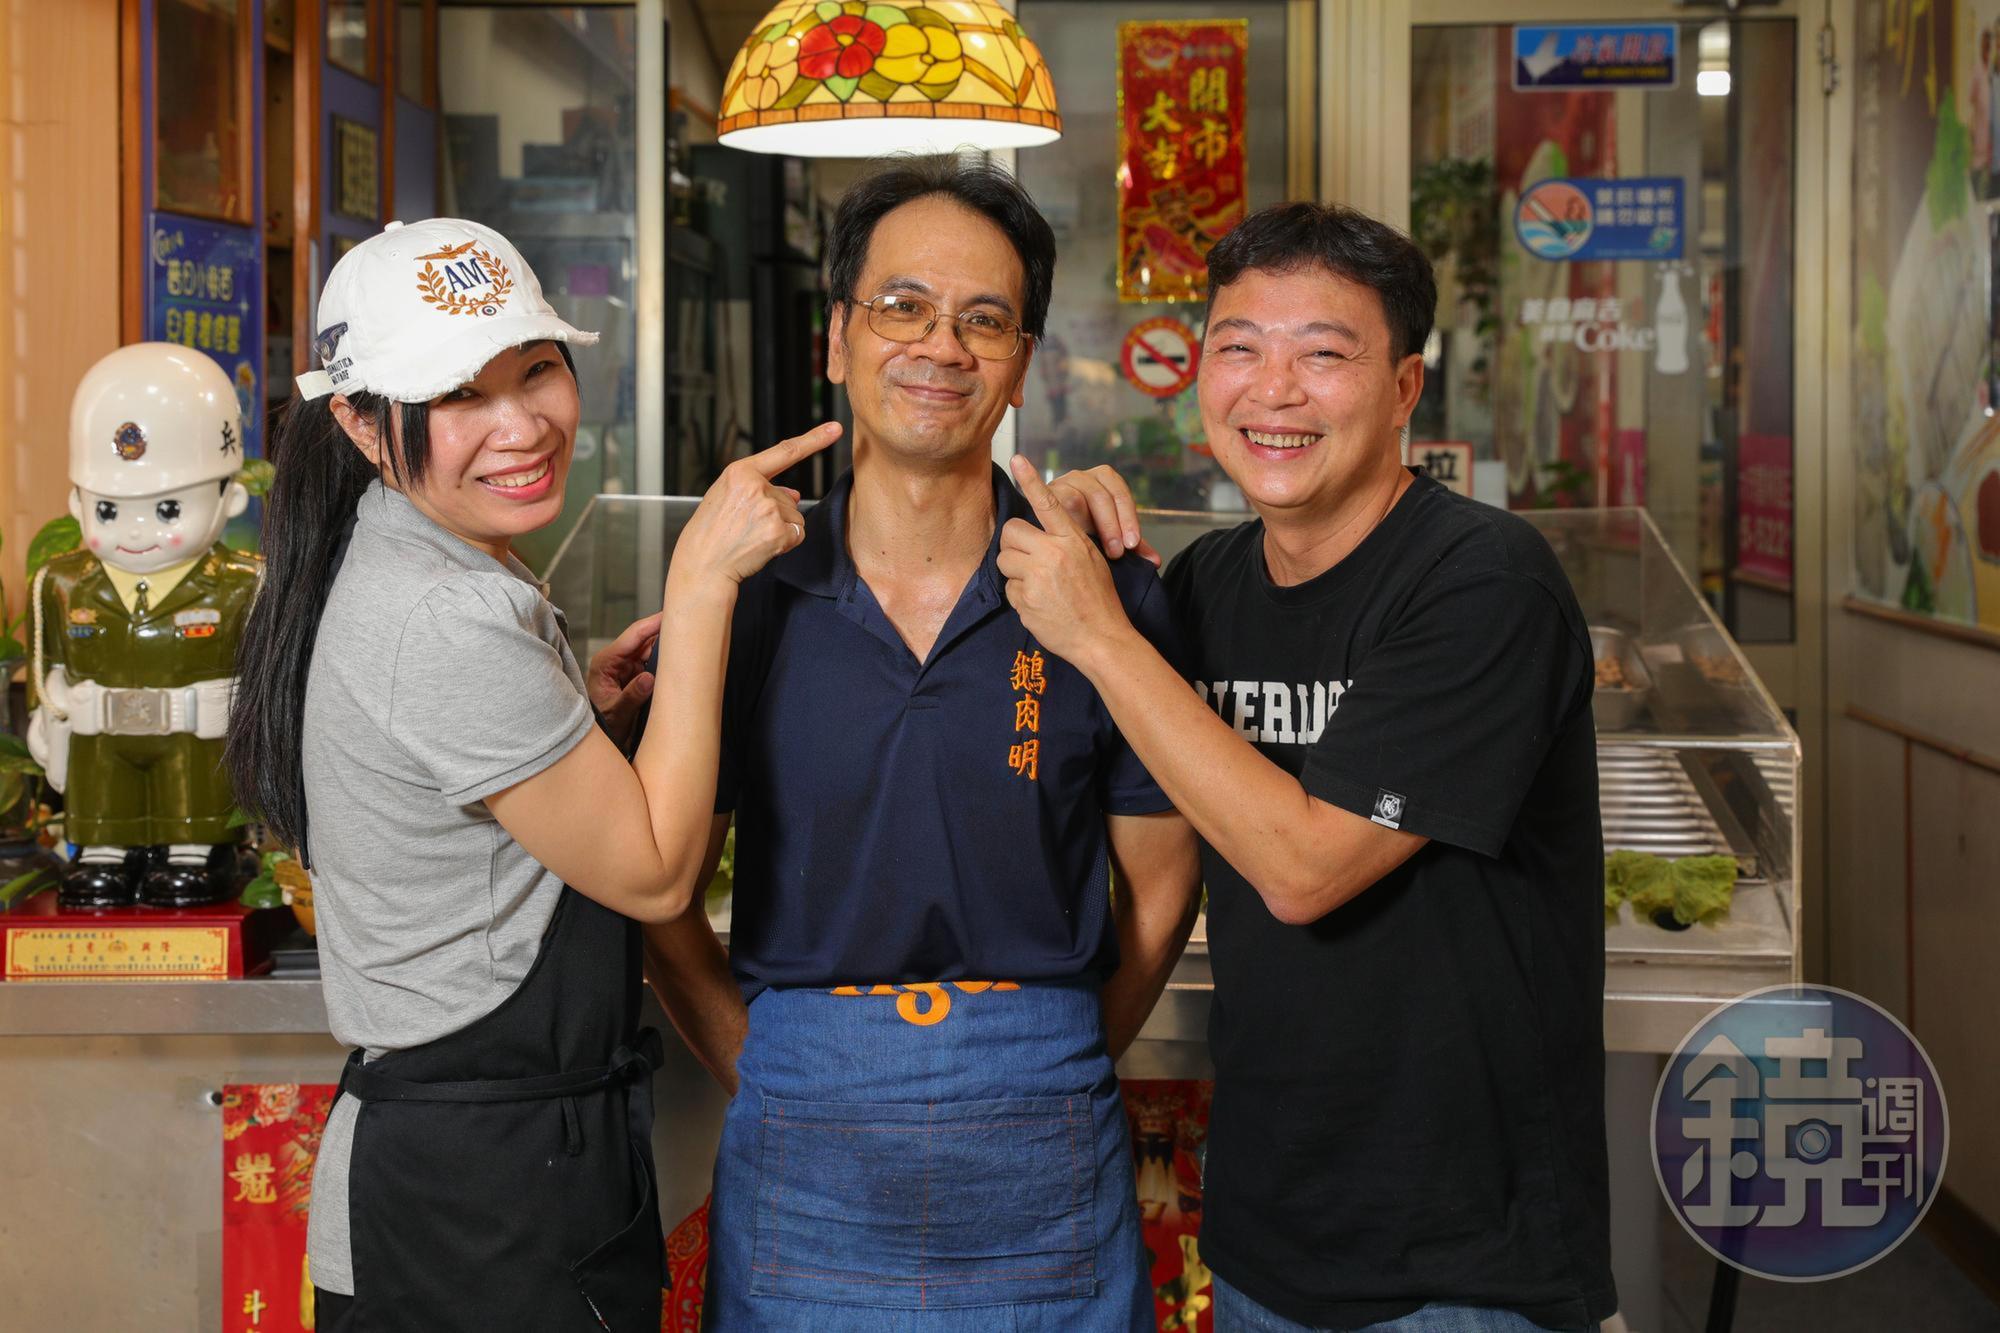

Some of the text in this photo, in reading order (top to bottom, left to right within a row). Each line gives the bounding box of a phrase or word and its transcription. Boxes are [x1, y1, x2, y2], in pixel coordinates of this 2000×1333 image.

[1141, 90, 1182, 180] 大吉
[1189, 66, 1228, 168] 開市
[445, 258, 491, 293] AM
[1574, 321, 1656, 353] Coke
[1008, 650, 1047, 781] 鵝肉明
